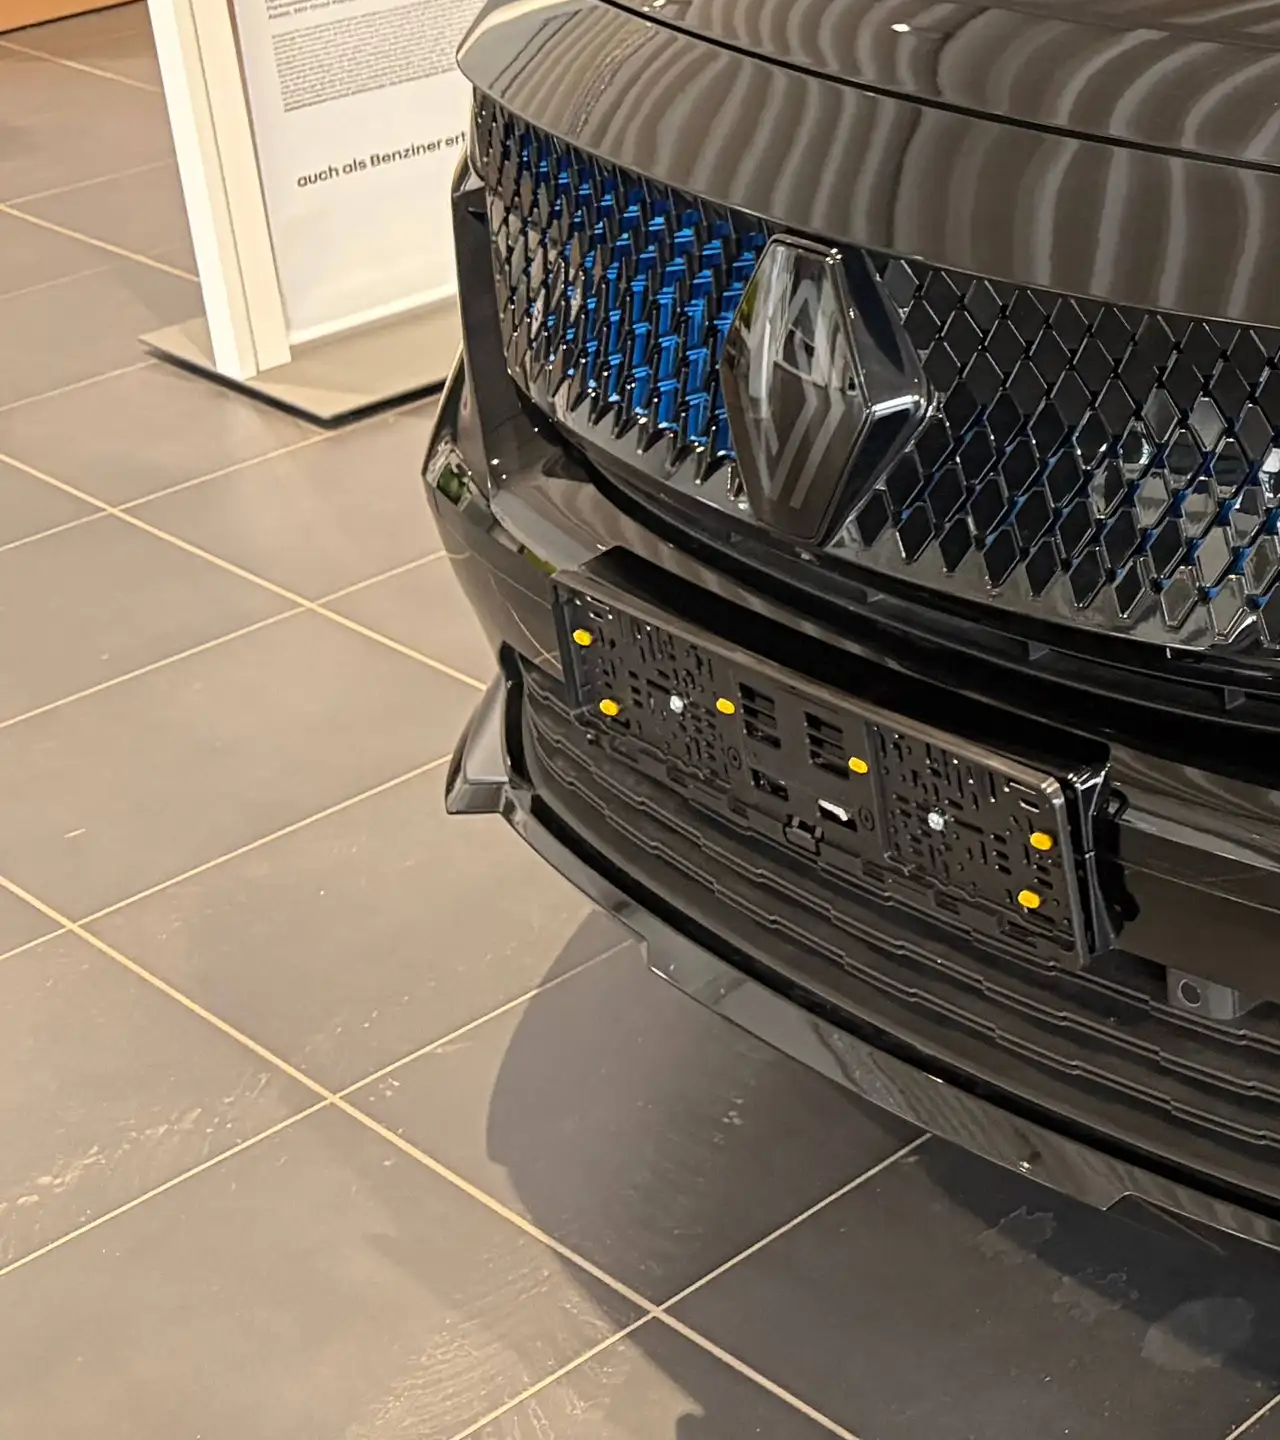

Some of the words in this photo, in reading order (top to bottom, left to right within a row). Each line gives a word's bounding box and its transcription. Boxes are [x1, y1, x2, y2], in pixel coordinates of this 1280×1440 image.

[297, 165, 339, 188] auch
[342, 155, 367, 175] als
[370, 139, 443, 167] Benziner
